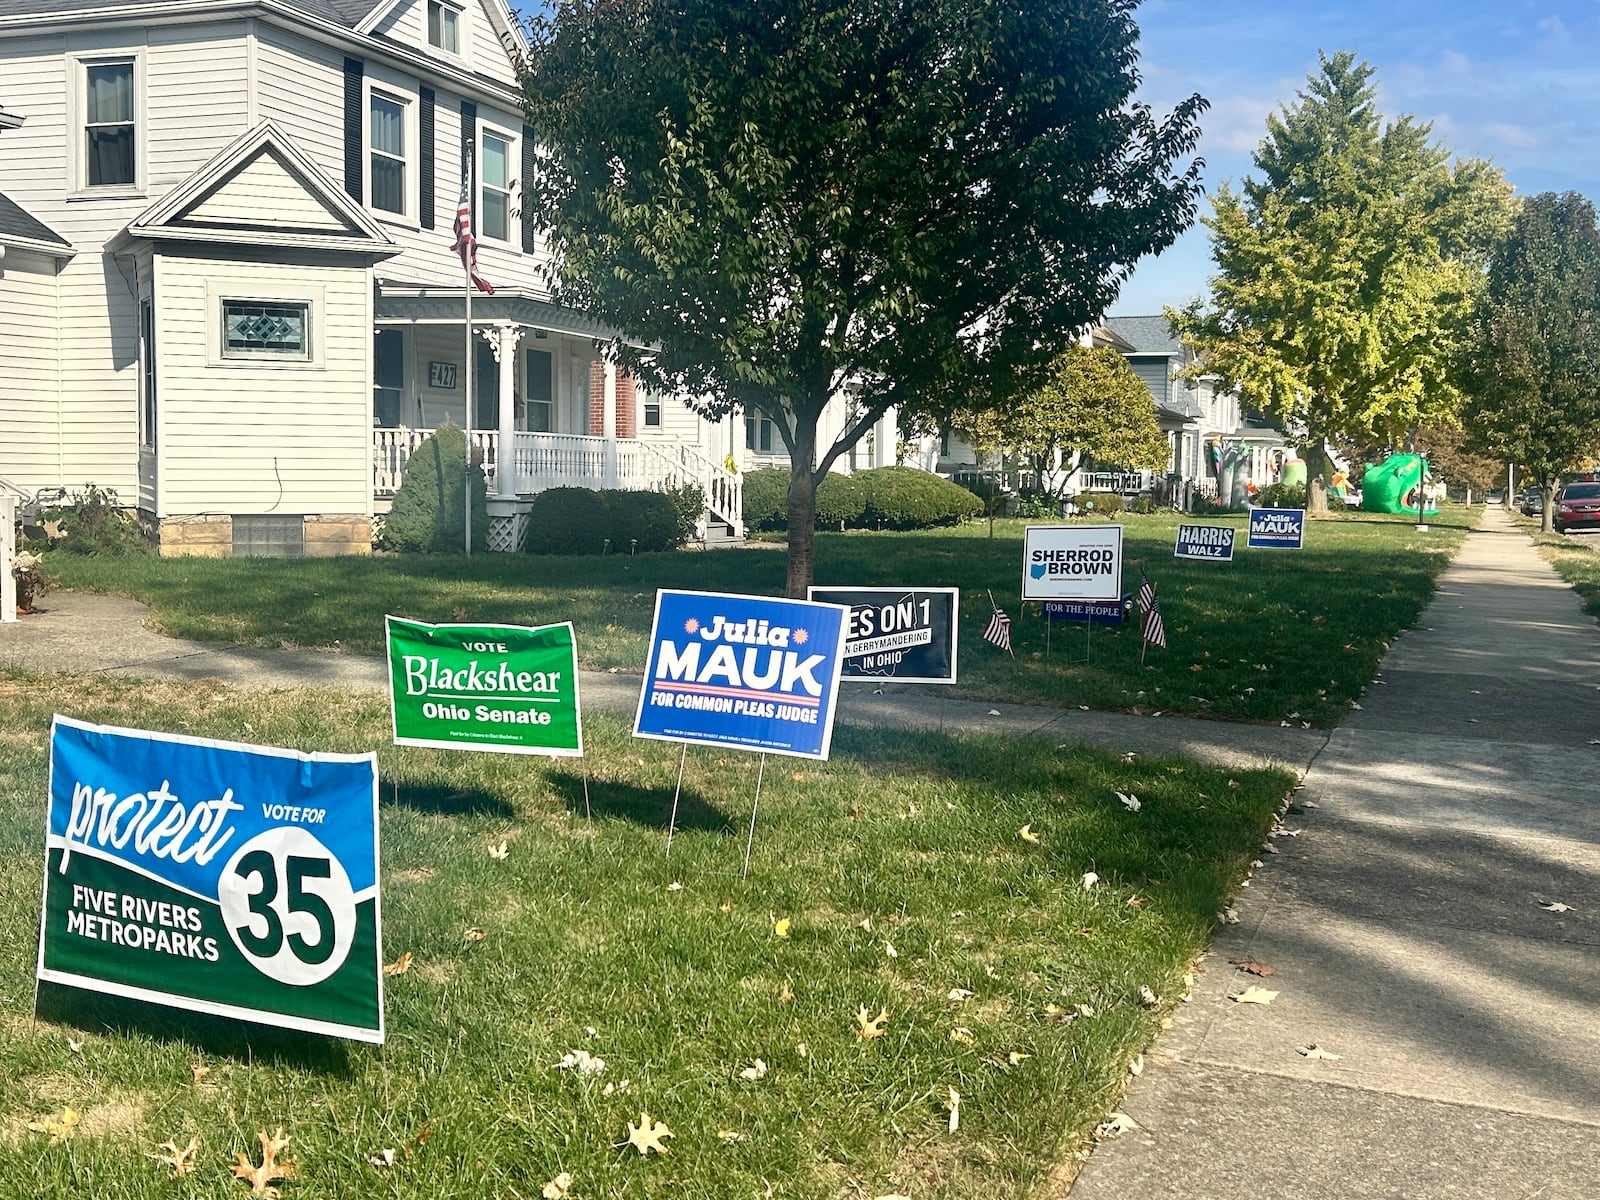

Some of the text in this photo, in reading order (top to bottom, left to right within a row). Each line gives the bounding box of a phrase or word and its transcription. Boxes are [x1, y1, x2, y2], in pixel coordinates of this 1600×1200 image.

[437, 365, 455, 386] 427
[1252, 521, 1300, 534] MAUK
[1264, 514, 1290, 522] Julia
[1180, 526, 1232, 546] HARRIS
[1032, 550, 1113, 562] SHERROD
[1187, 545, 1222, 556] WALZ
[1048, 562, 1113, 574] BROWN
[846, 599, 930, 639] ES ON 1
[1046, 603, 1120, 616] FOR THE PEOPLE
[700, 615, 790, 648] Julia
[462, 642, 508, 653] VOTE
[853, 632, 928, 653] GERRYMANDERING
[655, 639, 826, 697] MAUK
[863, 651, 902, 669] IN OHIO
[402, 655, 560, 696] Blackshear
[422, 703, 552, 725] Ohio Senate
[650, 691, 819, 724] FOR COMMON PLEAS JUDGE
[262, 803, 326, 824] VOTE FOR
[59, 779, 244, 875] protect
[72, 884, 202, 932] FIVE RIVERS
[233, 849, 336, 965] 35
[66, 910, 220, 962] METROPARKS
